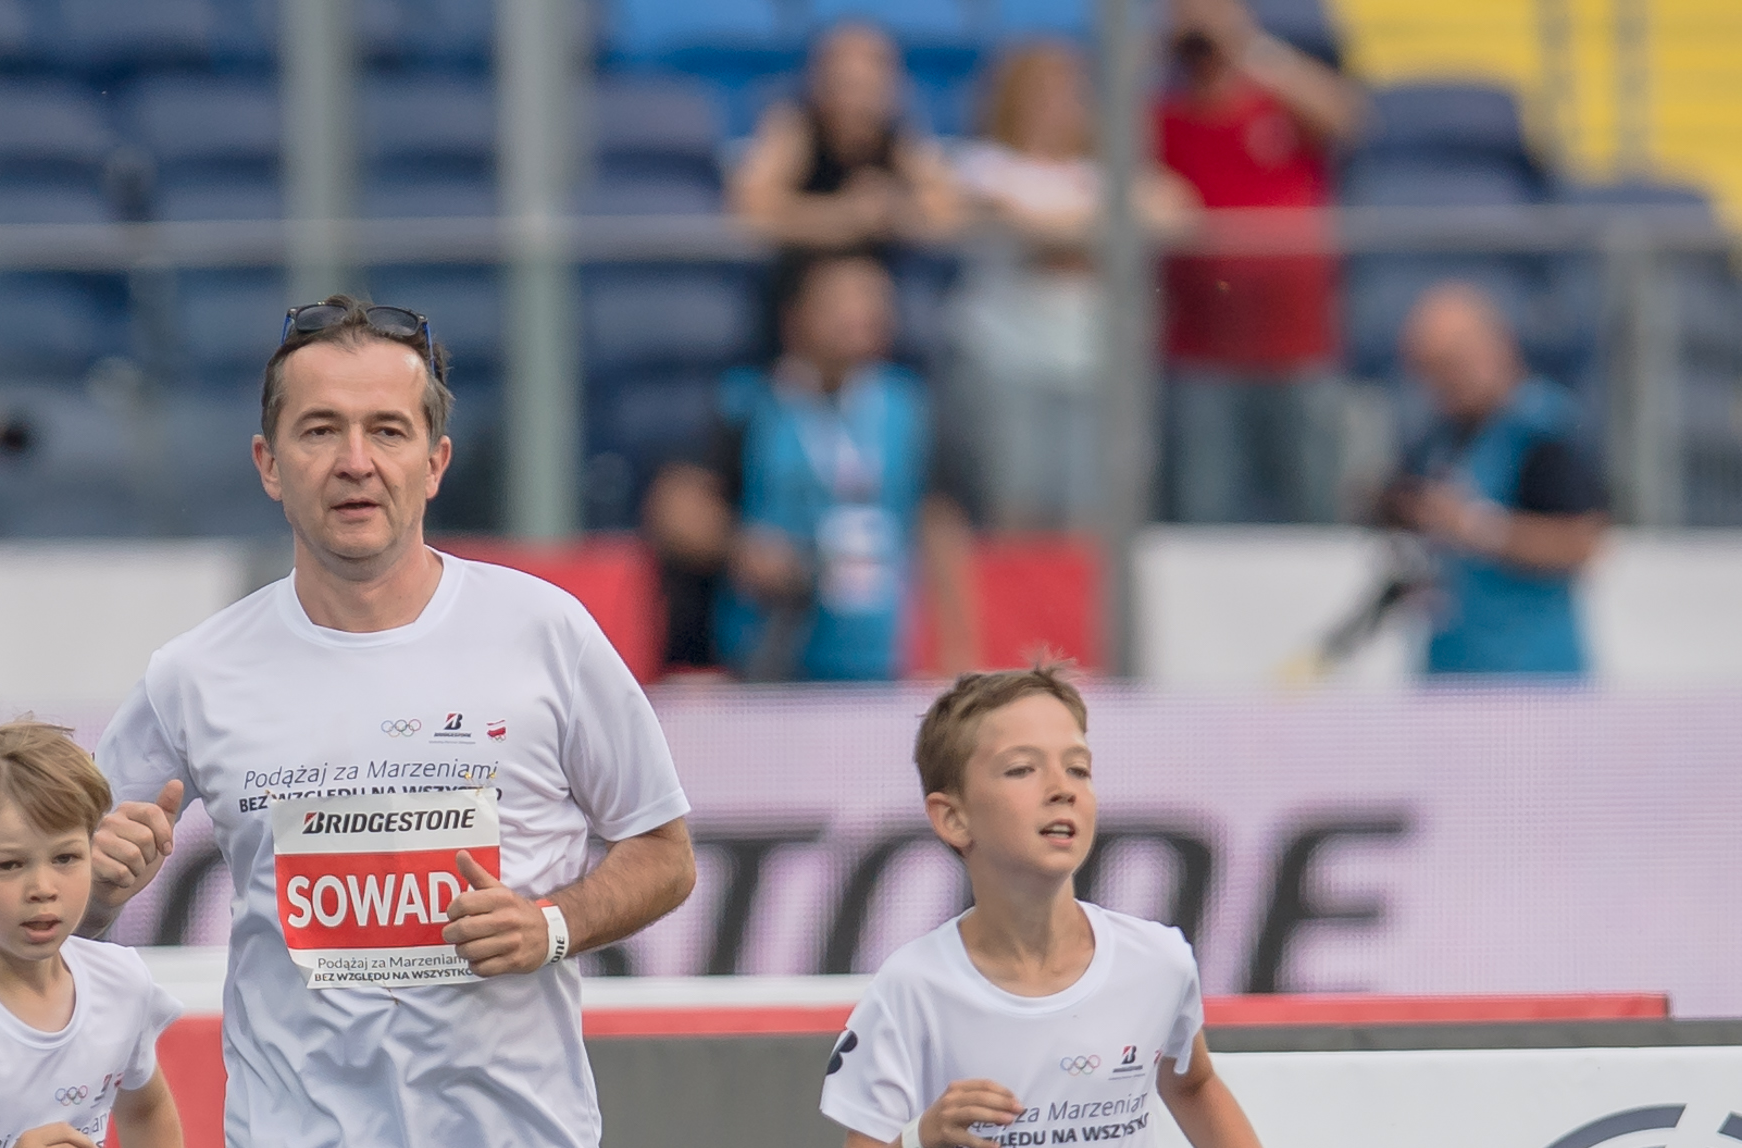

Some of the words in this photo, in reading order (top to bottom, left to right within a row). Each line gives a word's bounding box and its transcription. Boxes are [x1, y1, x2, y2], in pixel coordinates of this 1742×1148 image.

[243, 762, 328, 790] Podążaj
[333, 765, 359, 781] za
[366, 758, 499, 781] Marzeniami
[239, 795, 269, 814] BEZ
[302, 808, 476, 835] BRIDGESTONE
[286, 871, 468, 929] SOWAD
[317, 957, 369, 971] Podążaj
[371, 960, 386, 969] za
[389, 954, 469, 968] Marzeniam
[314, 973, 335, 982] BEZ
[337, 972, 390, 983] WZGLĘDU
[392, 971, 409, 980] NA
[1015, 1107, 1040, 1124] za
[1048, 1092, 1148, 1121] Marzenia
[1051, 1128, 1077, 1144] NA
